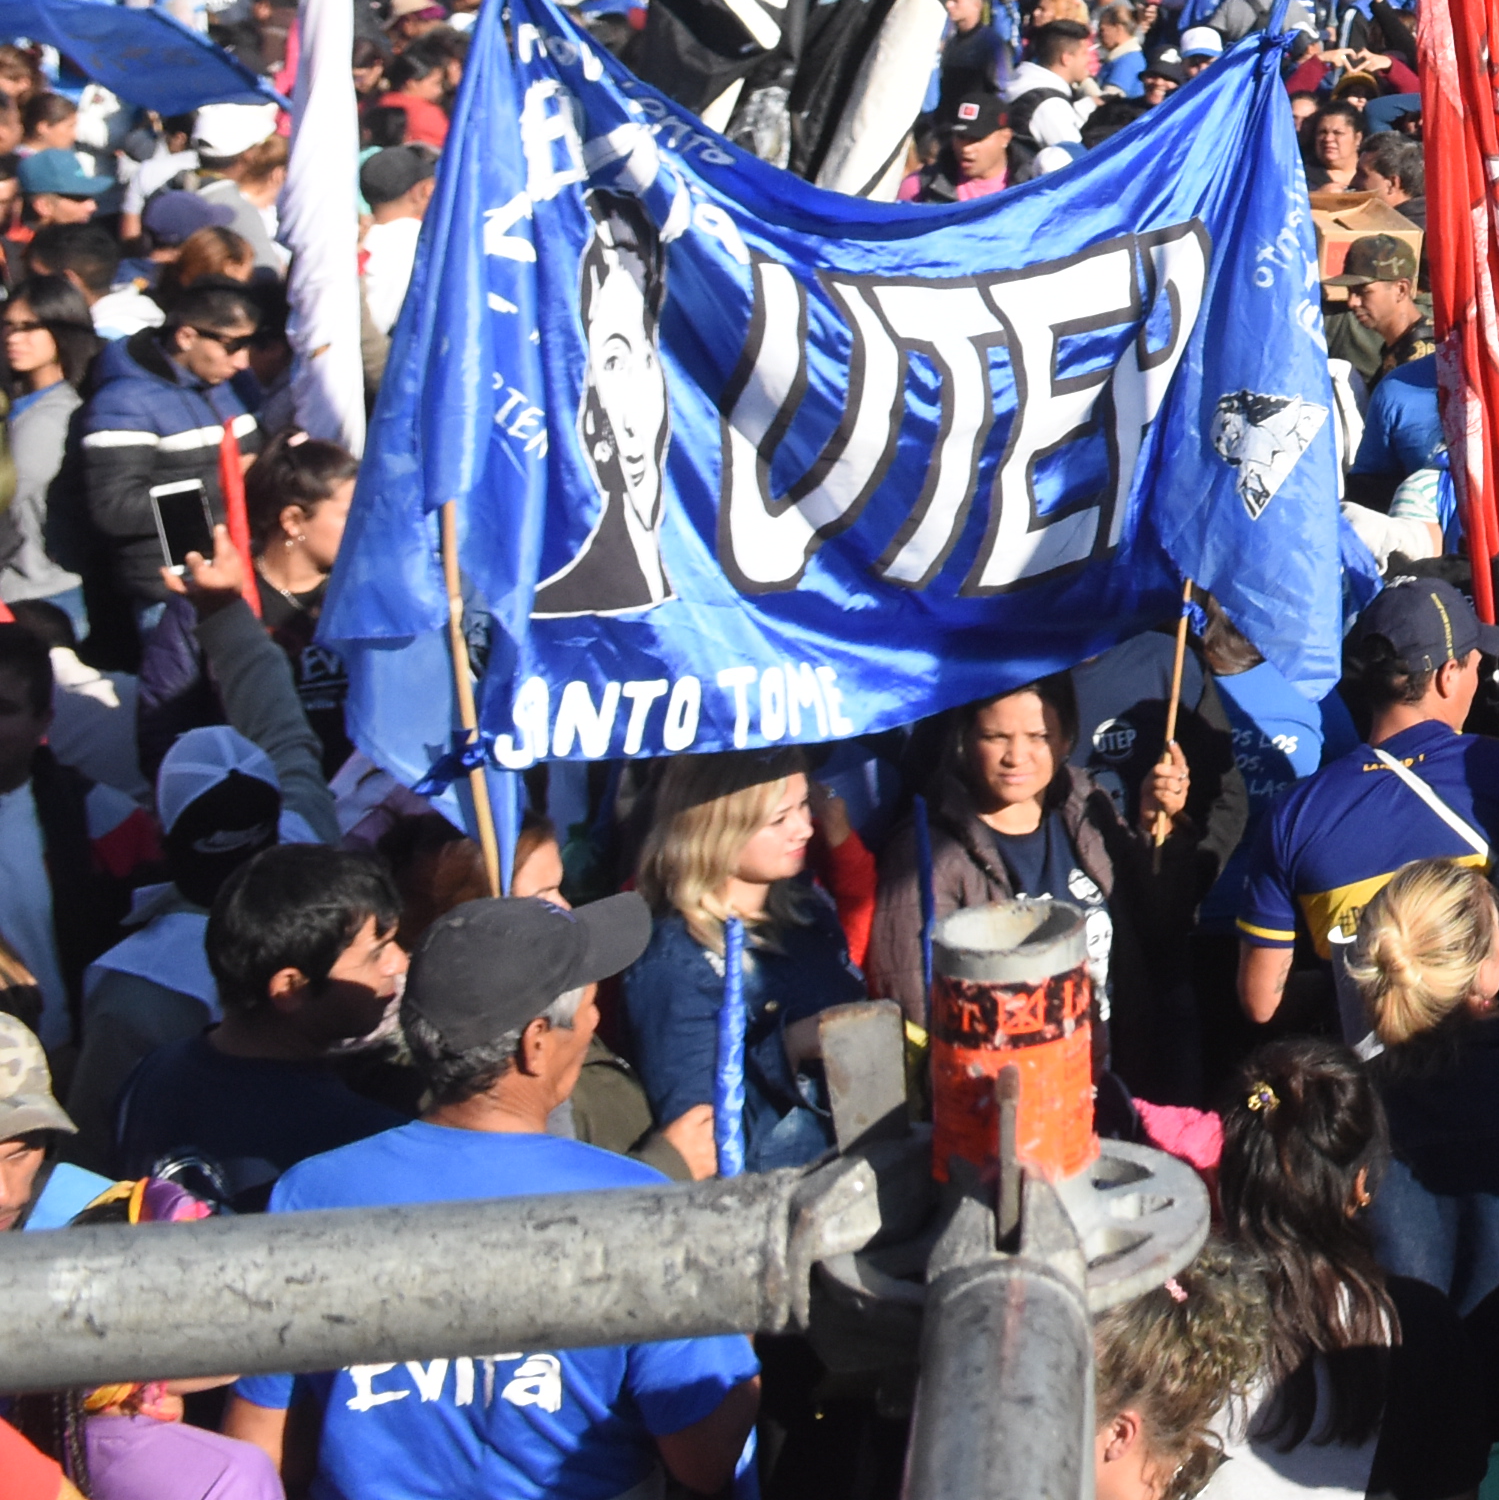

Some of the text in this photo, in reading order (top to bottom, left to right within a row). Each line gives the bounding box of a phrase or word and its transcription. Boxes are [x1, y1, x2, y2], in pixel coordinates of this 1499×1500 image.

[717, 216, 1212, 600] UTEP
[717, 661, 854, 750] TOME
[346, 1352, 562, 1413] Evita
